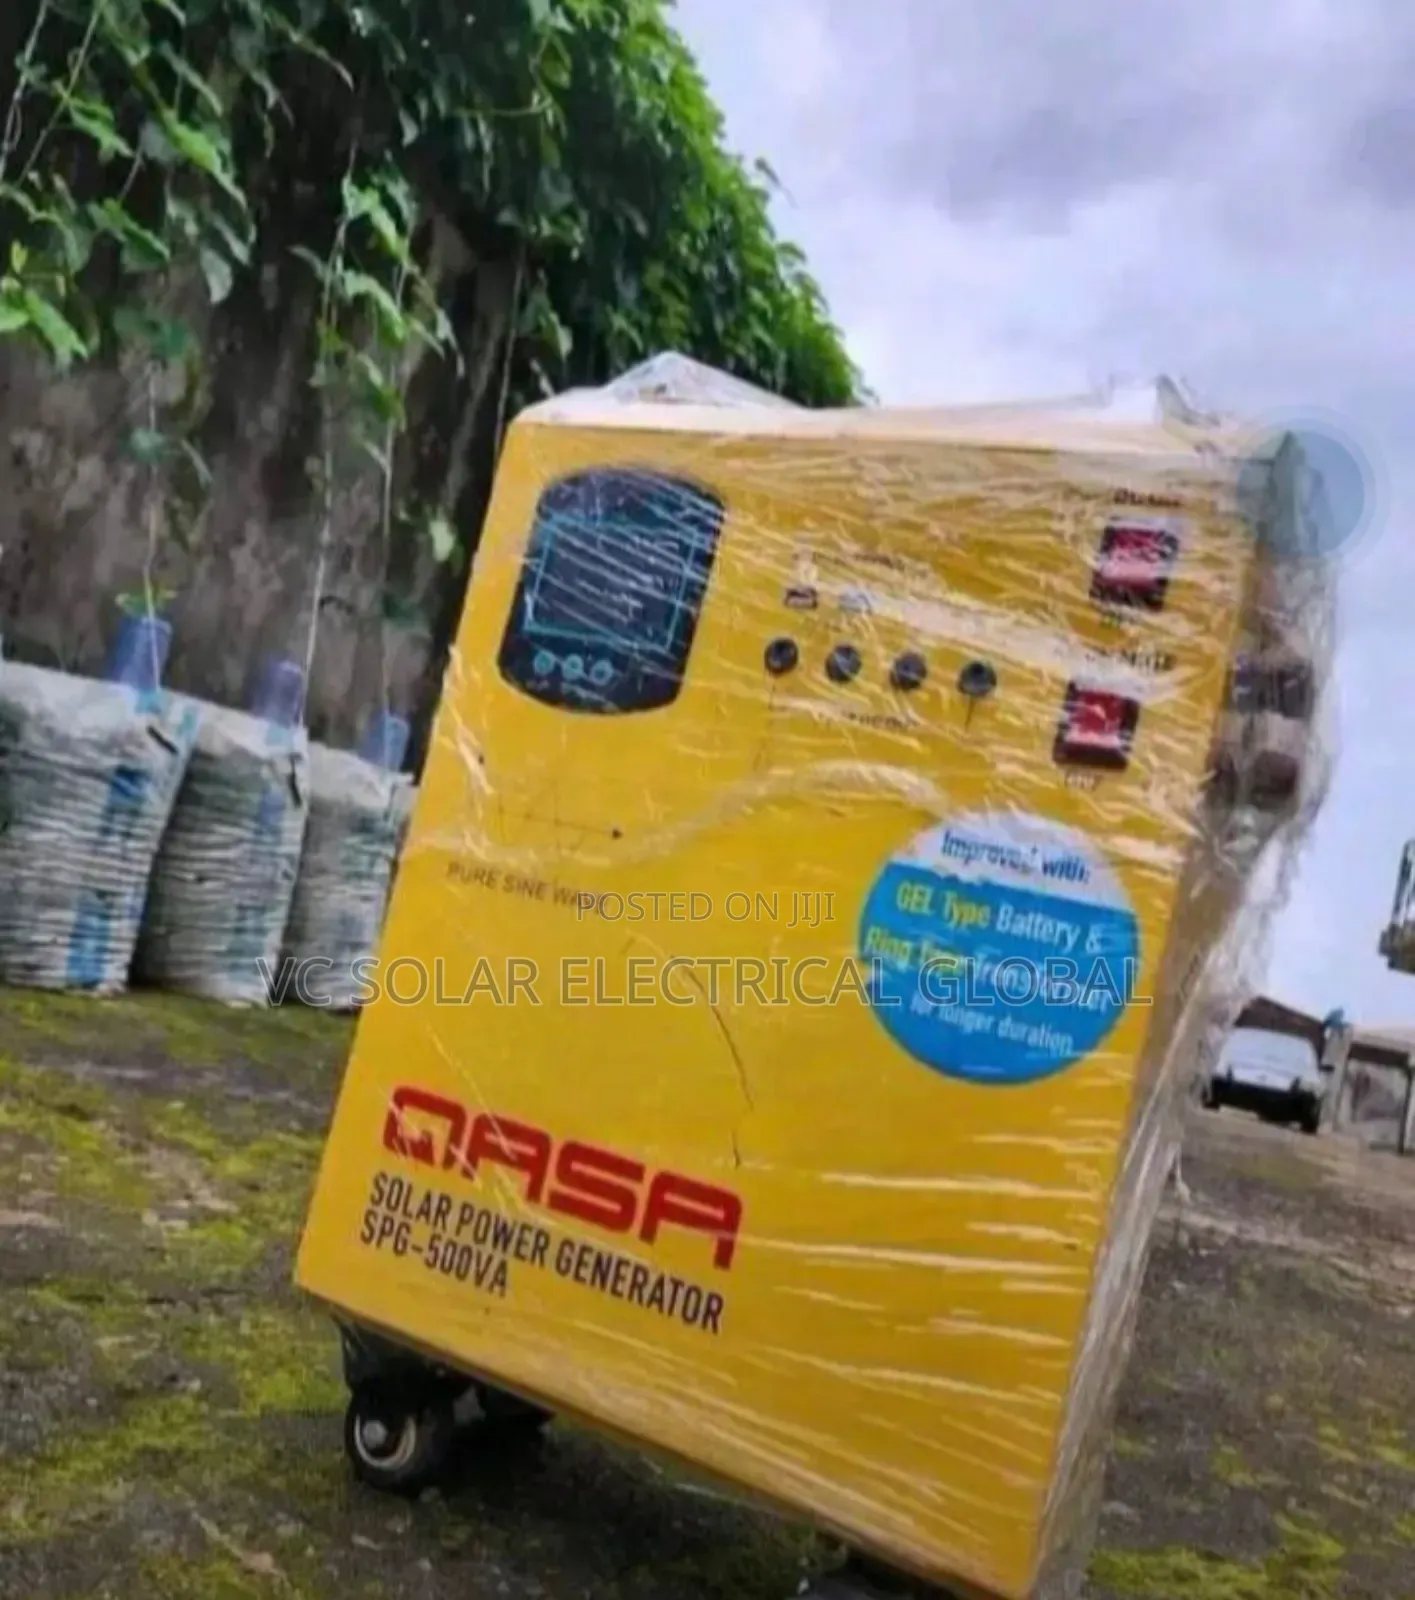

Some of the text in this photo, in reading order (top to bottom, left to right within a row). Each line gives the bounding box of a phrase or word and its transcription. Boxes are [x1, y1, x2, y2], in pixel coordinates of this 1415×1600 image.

[446, 861, 498, 889] PURE
[503, 873, 546, 900] SINE
[896, 881, 1104, 955] GEL Type Battery &
[998, 1014, 1076, 1057] duration
[382, 1084, 744, 1271] QASA
[359, 1208, 510, 1299] SPG-500VA
[368, 1170, 726, 1336] SOLAR POWER GENERATOR
